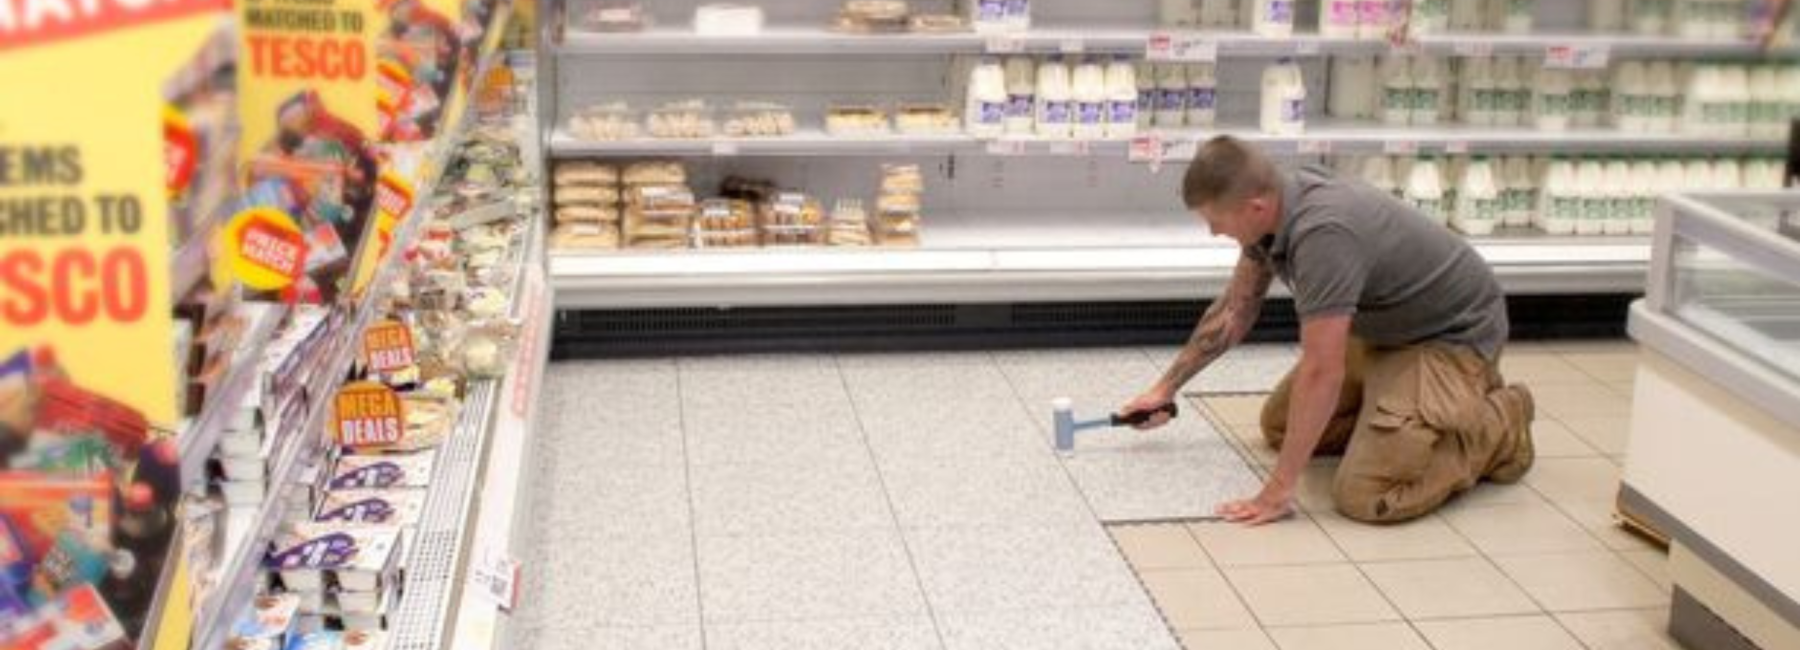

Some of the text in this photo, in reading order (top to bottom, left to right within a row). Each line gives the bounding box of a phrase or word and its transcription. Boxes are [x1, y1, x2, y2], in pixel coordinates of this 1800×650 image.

[244, 9, 363, 34] MATCHED TO
[245, 36, 366, 80] TESCO
[94, 194, 142, 235] TO
[369, 346, 413, 370] DEALS
[340, 391, 398, 420] MEGA
[342, 416, 399, 445] DEALS
